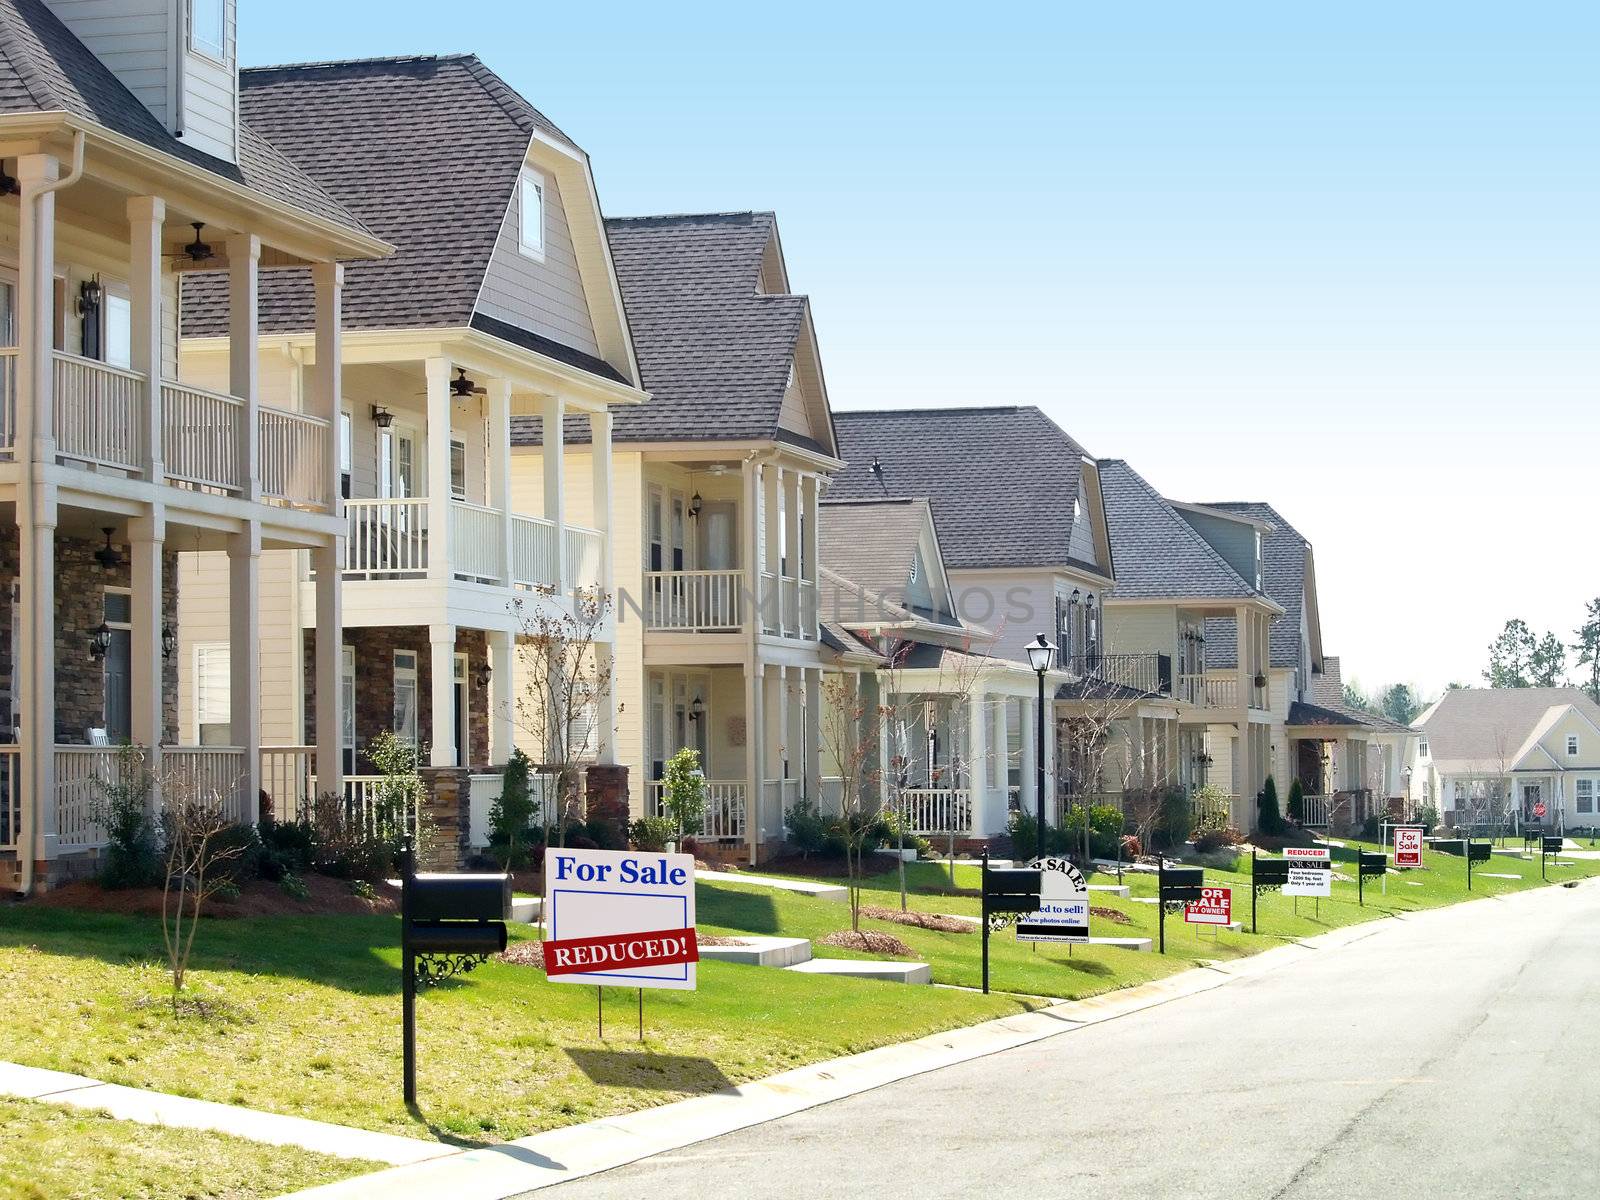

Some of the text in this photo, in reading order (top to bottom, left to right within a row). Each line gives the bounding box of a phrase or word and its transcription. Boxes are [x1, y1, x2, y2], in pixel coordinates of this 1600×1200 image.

[1402, 832, 1415, 840] For
[1398, 841, 1418, 850] Sale
[1306, 861, 1323, 869] SALE
[555, 856, 687, 886] For Sale
[1046, 858, 1087, 893] SALE!
[1201, 889, 1224, 899] OR
[1053, 905, 1062, 913] to
[1063, 905, 1084, 914] sell!
[554, 936, 688, 967] REDUCED!
